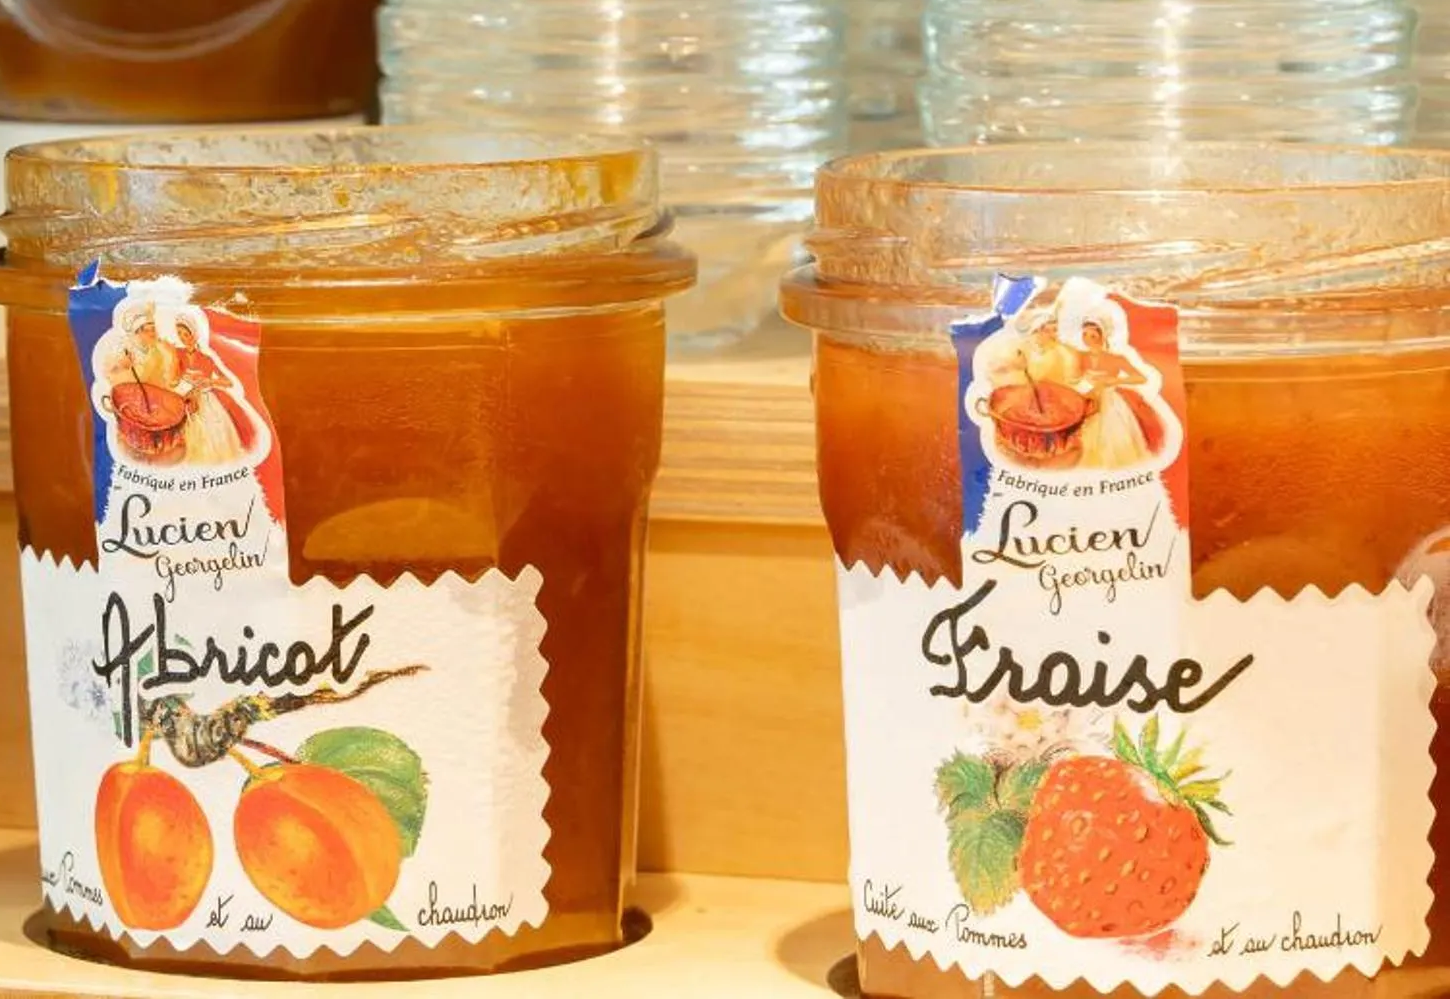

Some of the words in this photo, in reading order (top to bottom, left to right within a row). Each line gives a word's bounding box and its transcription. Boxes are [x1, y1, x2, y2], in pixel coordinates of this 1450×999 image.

[117, 464, 175, 491] Fabriqué
[179, 480, 197, 491] en
[202, 466, 250, 489] France
[997, 469, 1069, 498] Fabriqué
[1073, 485, 1094, 497] en
[1100, 471, 1154, 494] France
[102, 494, 256, 558] Lucien
[971, 500, 1161, 568] Lucien
[154, 528, 271, 603] Georgelin
[1039, 536, 1177, 616] Georgelin
[92, 591, 375, 749] Abricot
[921, 579, 1254, 714] Fraise
[206, 894, 234, 929] et
[240, 912, 274, 933] au
[417, 881, 515, 931] chaudron
[863, 878, 905, 920] Cuite
[908, 912, 939, 934] aux
[945, 903, 1028, 950] Pommes
[1207, 922, 1240, 957] et
[1239, 933, 1277, 956] au
[1280, 910, 1383, 951] chaudron
